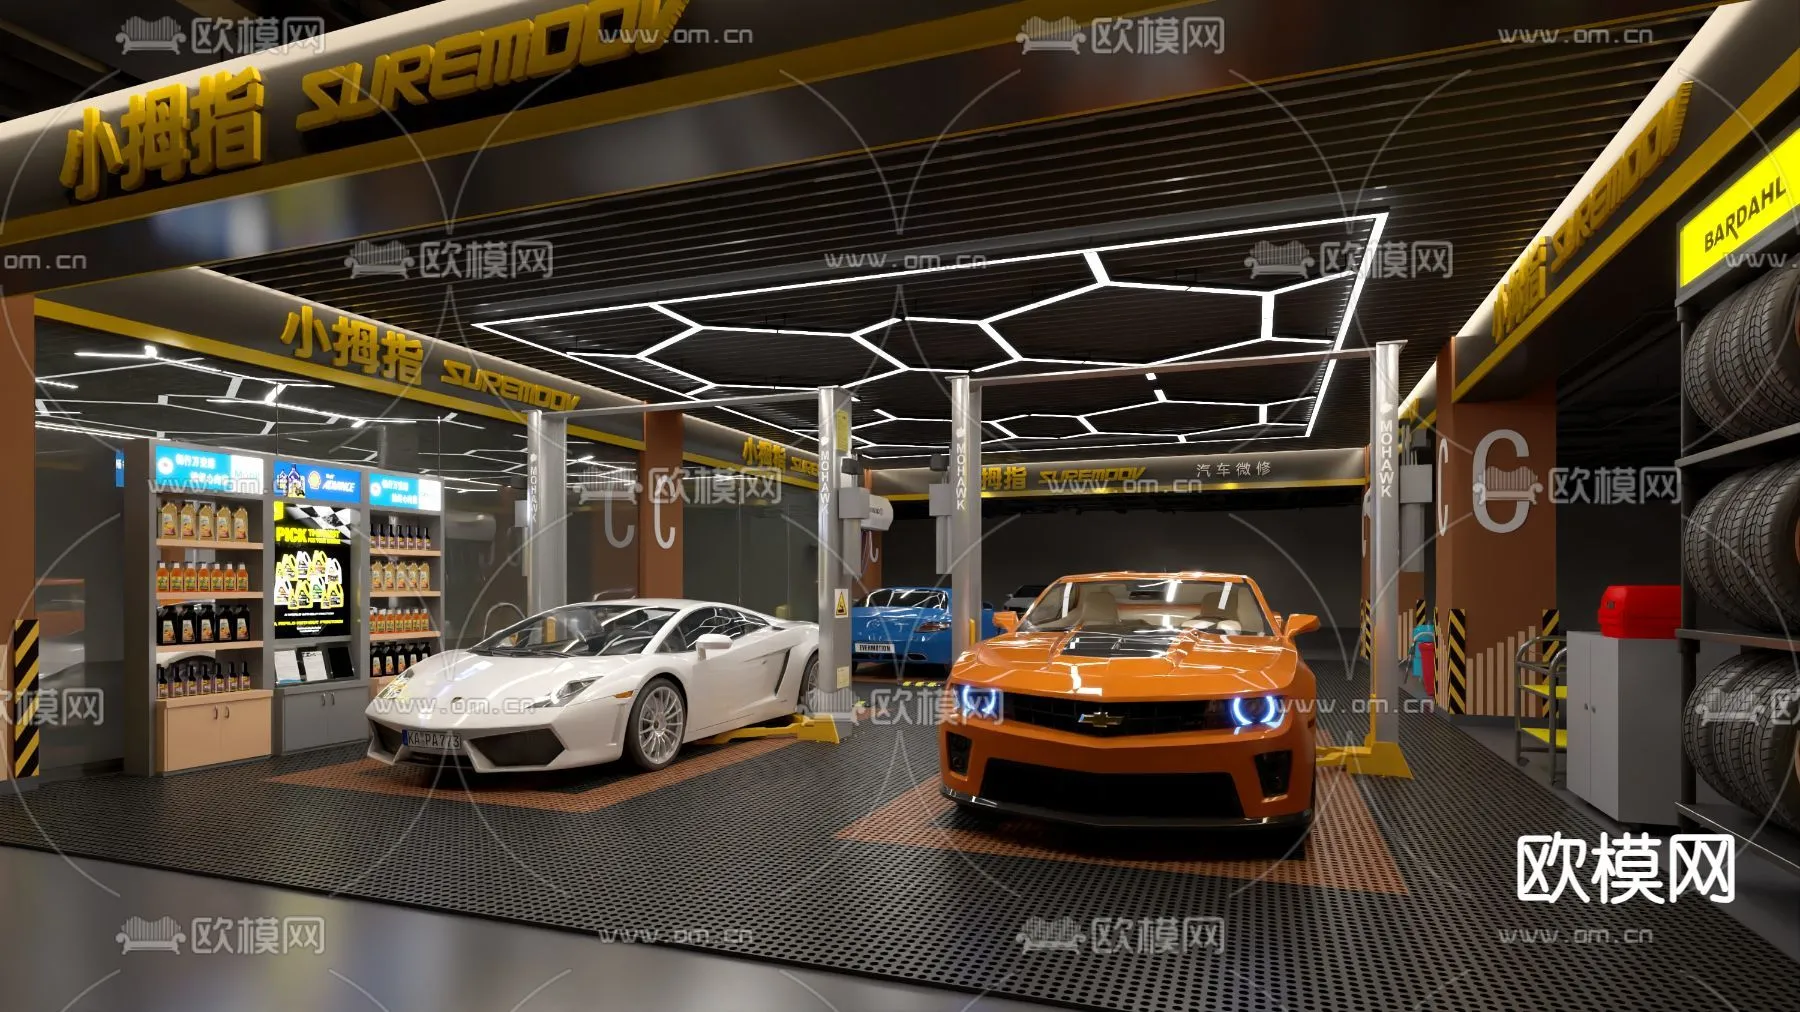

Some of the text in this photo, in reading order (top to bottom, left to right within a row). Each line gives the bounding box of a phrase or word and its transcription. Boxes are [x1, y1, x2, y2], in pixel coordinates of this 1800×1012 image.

[59, 65, 264, 201] 小拇指
[1704, 176, 1787, 253] BARDAHL
[280, 305, 424, 386] 小拇指
[820, 451, 831, 515] MOHAWK
[955, 442, 968, 511] MOHAWK
[1196, 461, 1271, 477] 汽车微修
[1378, 419, 1395, 498] MOHAWK
[1472, 429, 1530, 533] C
[276, 527, 308, 543] PICK
[407, 730, 420, 746] KA
